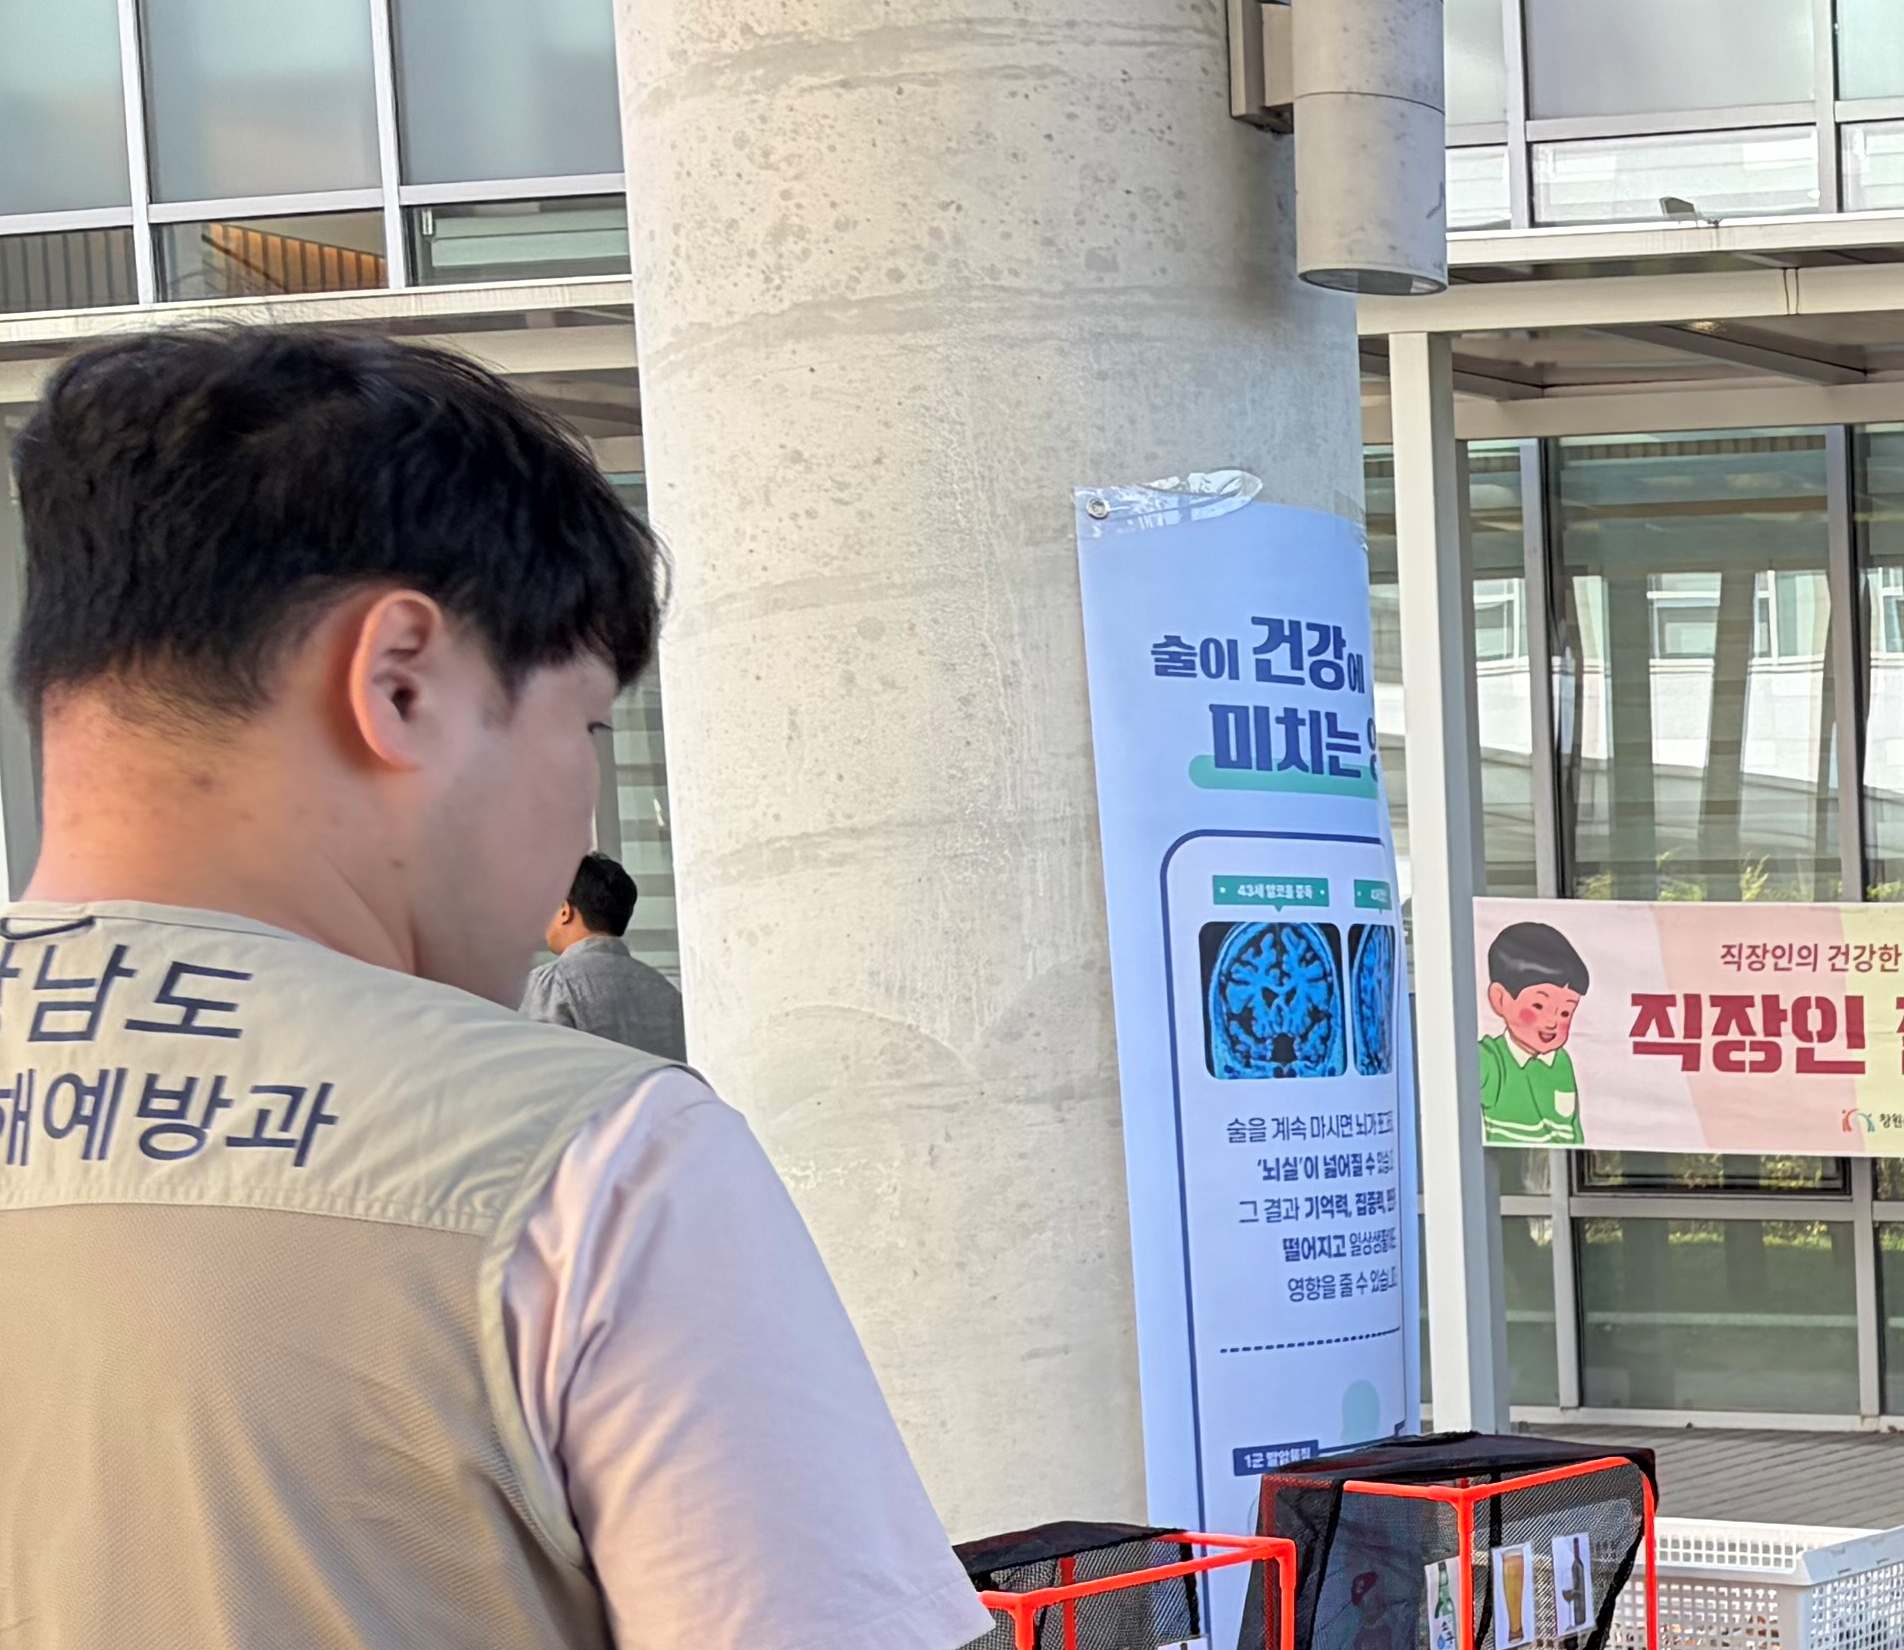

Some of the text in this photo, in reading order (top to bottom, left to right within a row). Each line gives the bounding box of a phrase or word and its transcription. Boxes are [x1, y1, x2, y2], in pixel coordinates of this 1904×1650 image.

[1151, 616, 1366, 694] 술이 건강에
[1208, 703, 1361, 779] 미치는
[1719, 943, 1818, 973] 직장인의
[1827, 943, 1902, 973] 건강한
[1629, 992, 1866, 1075] 직장인
[1226, 1117, 1267, 1144] 술을
[1271, 1115, 1307, 1141] 계속
[1310, 1113, 1354, 1140] 마시면
[1323, 1152, 1363, 1180] 넓어질
[1365, 1152, 1376, 1176] 수
[1239, 1200, 1260, 1224] 그
[1264, 1196, 1301, 1224] 결과
[1304, 1192, 1352, 1221] 기억력,
[1282, 1234, 1347, 1263] 떨어지고
[1287, 1273, 1336, 1303] 영향을
[1339, 1272, 1353, 1299] 줄
[1356, 1271, 1368, 1296] 수
